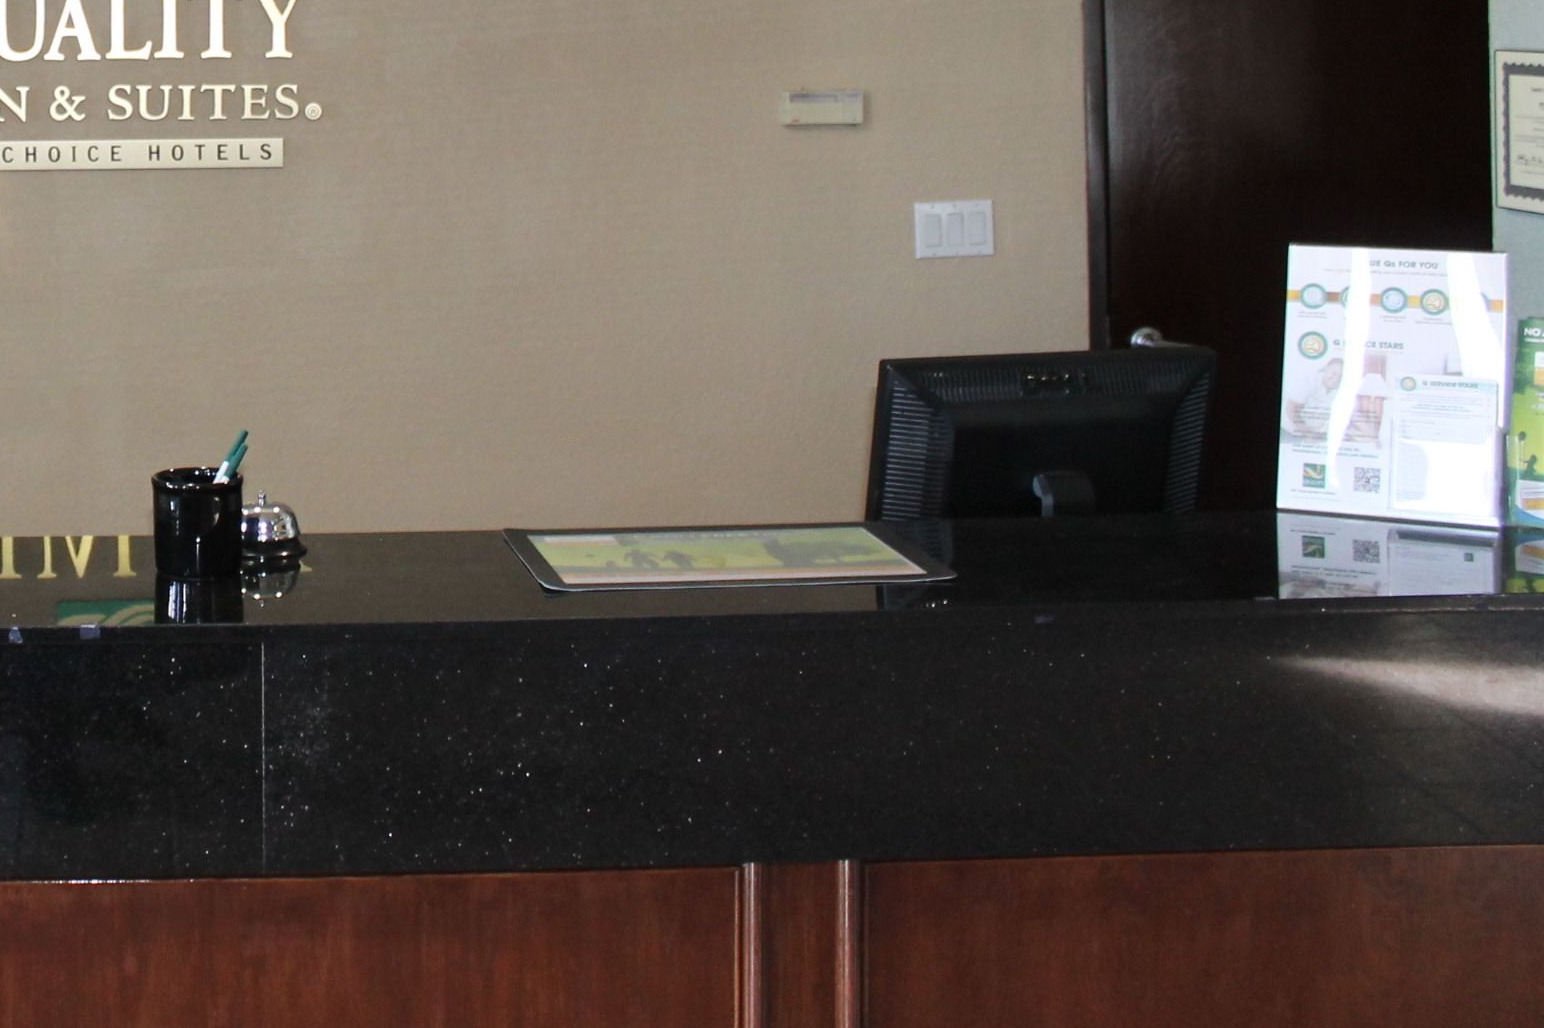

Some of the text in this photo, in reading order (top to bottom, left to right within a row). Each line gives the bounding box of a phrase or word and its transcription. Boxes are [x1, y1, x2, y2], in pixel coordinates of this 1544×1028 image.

[50, 84, 86, 121] &
[1, 145, 122, 163] CHOICE
[148, 143, 273, 161] HOTELS
